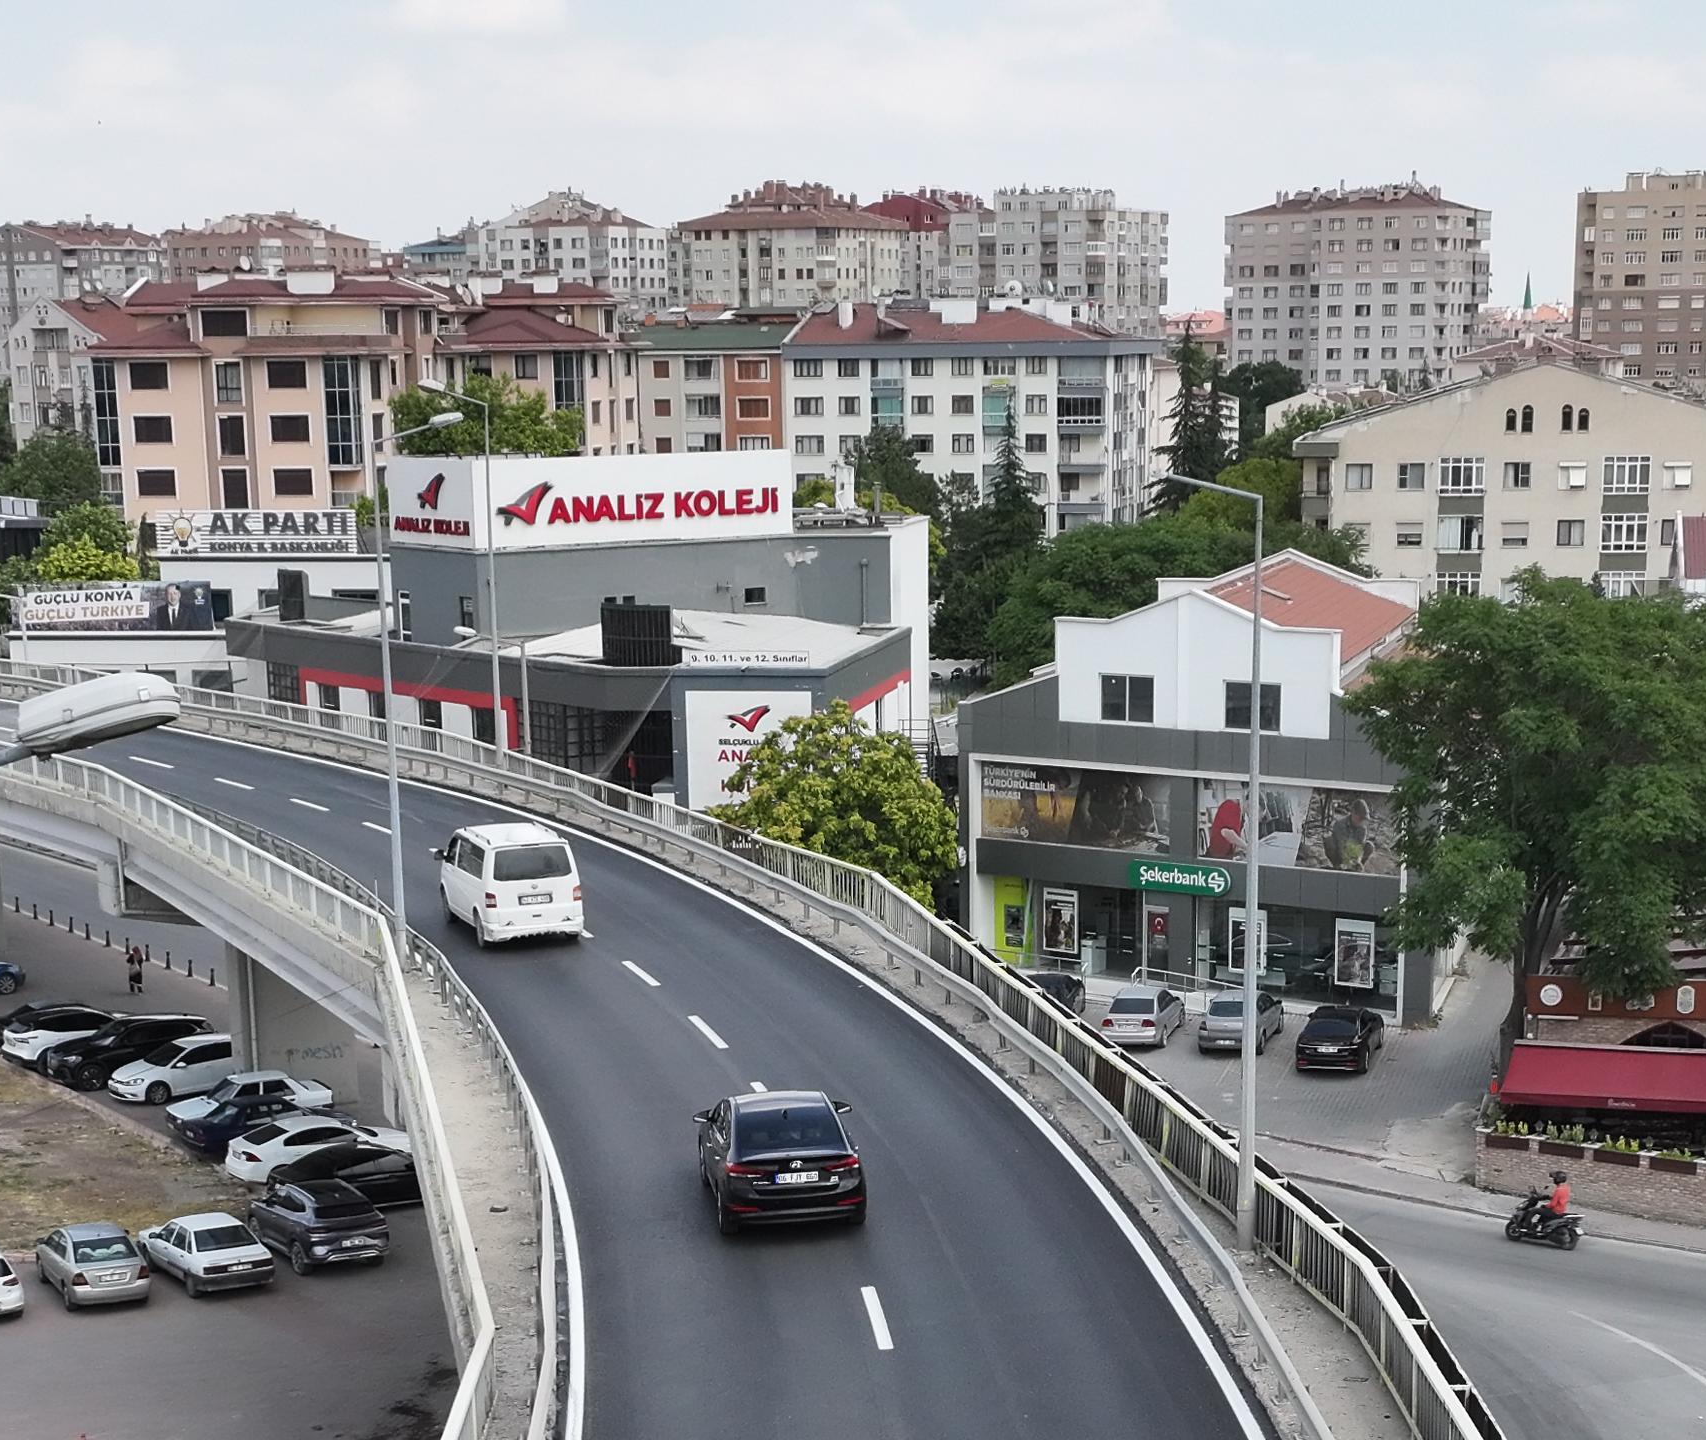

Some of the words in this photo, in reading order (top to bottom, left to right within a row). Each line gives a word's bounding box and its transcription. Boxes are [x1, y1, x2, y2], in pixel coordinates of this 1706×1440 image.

[548, 492, 665, 525] ANALİZ
[674, 486, 779, 518] KOLEJİ
[209, 512, 253, 536] AK
[393, 515, 433, 534] ANALİZ
[433, 518, 471, 537] KOLEJİ
[209, 541, 253, 553] KONYA
[34, 592, 80, 606] GÜÇLÜ
[84, 589, 134, 603] KONYA
[24, 606, 76, 622] GÜÇLÜ
[81, 604, 145, 618] TÜRKİYE
[1139, 865, 1206, 886] Şekerbank
